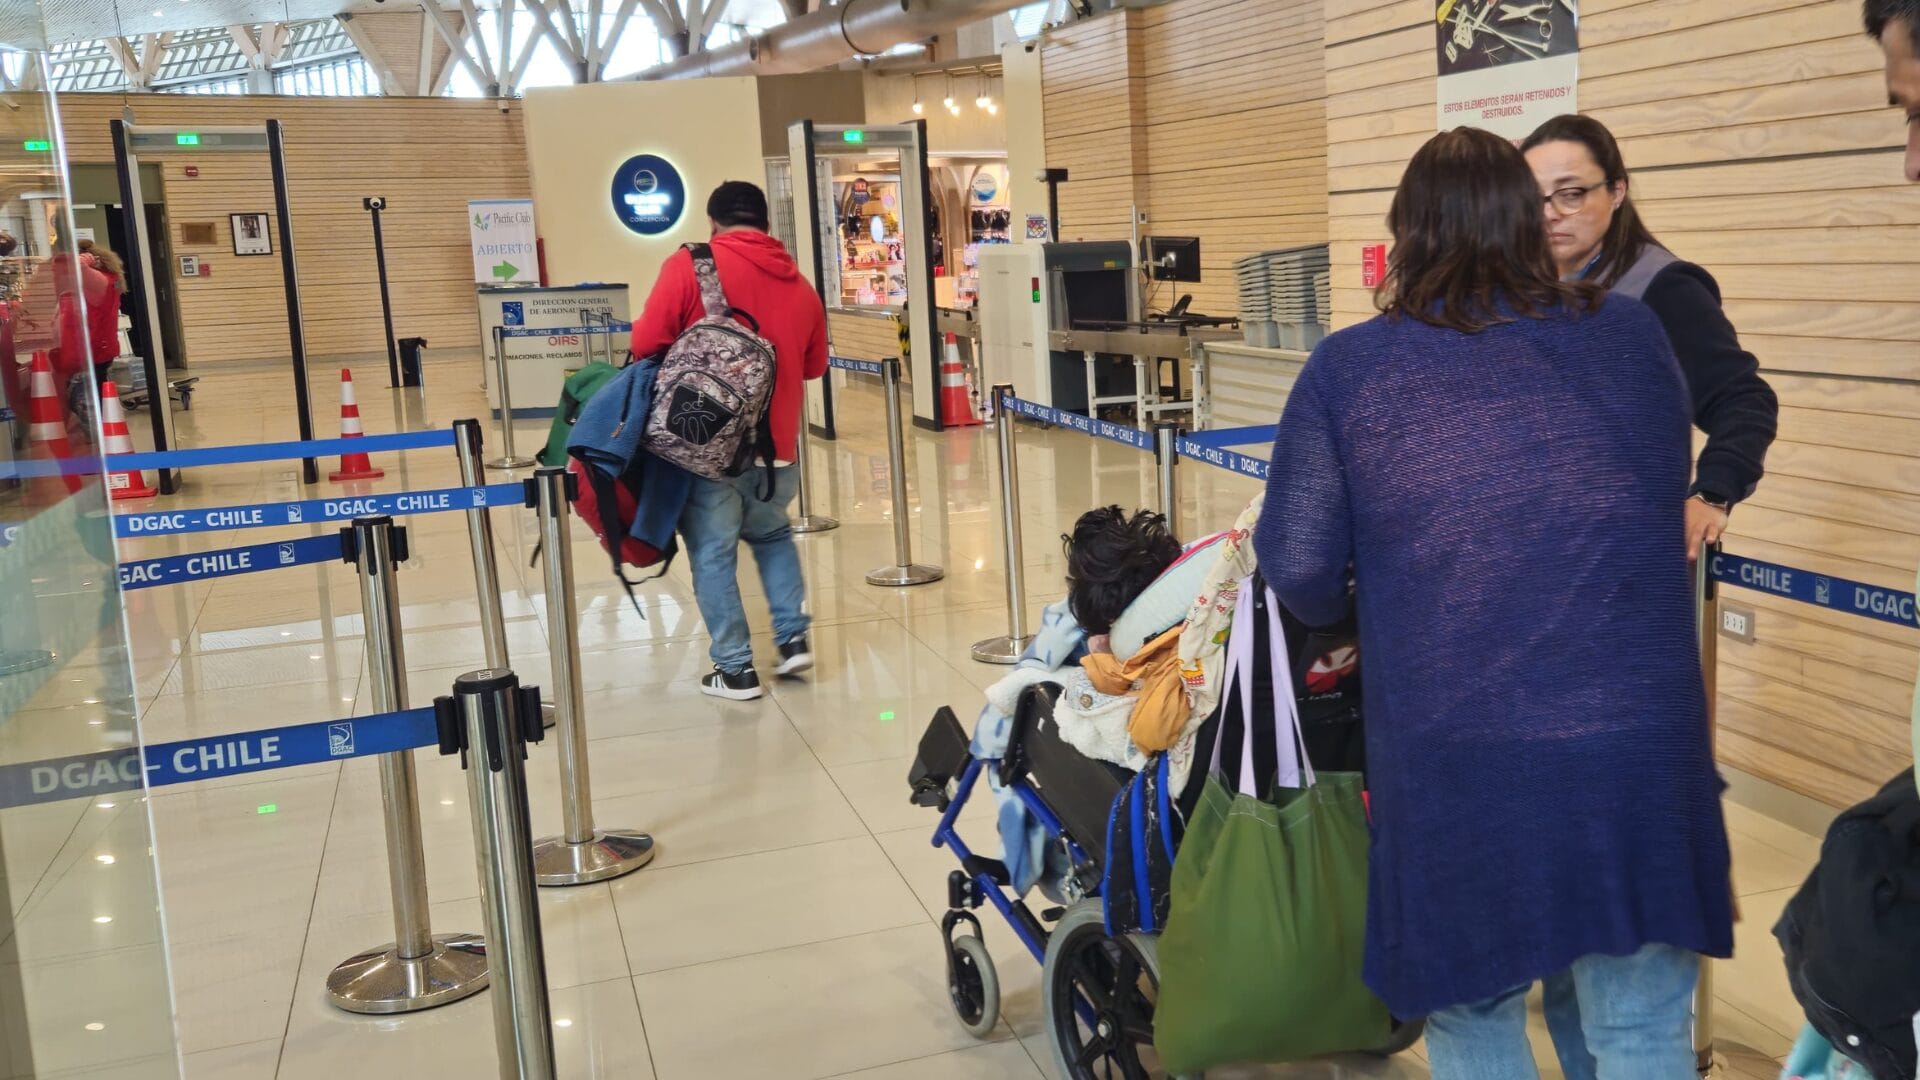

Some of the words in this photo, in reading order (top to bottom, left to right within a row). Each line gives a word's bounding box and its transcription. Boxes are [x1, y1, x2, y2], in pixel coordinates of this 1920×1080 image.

[1443, 102, 1463, 113] ESTOS
[1464, 97, 1499, 111] ELEMENTOS
[1525, 87, 1566, 101] RETENIDOS
[1566, 86, 1572, 96] Y
[493, 211, 514, 224] Pacific
[515, 211, 531, 223] Club
[477, 243, 532, 256] ABIERTO
[542, 306, 596, 314] AERONAUA
[1185, 441, 1201, 457] DGAC
[1205, 448, 1223, 465] CHILE
[1241, 457, 1259, 475] DGAC
[324, 499, 377, 517] DGAC
[396, 494, 450, 511] CHILE
[128, 514, 186, 532] DGAC
[206, 510, 263, 527] CHILE
[119, 562, 163, 585] GAC
[186, 551, 252, 576] CHILE
[1740, 563, 1792, 593] CHILE
[1854, 587, 1913, 620] DGAC
[30, 754, 142, 794] DGAC
[172, 736, 281, 775] CHILE
